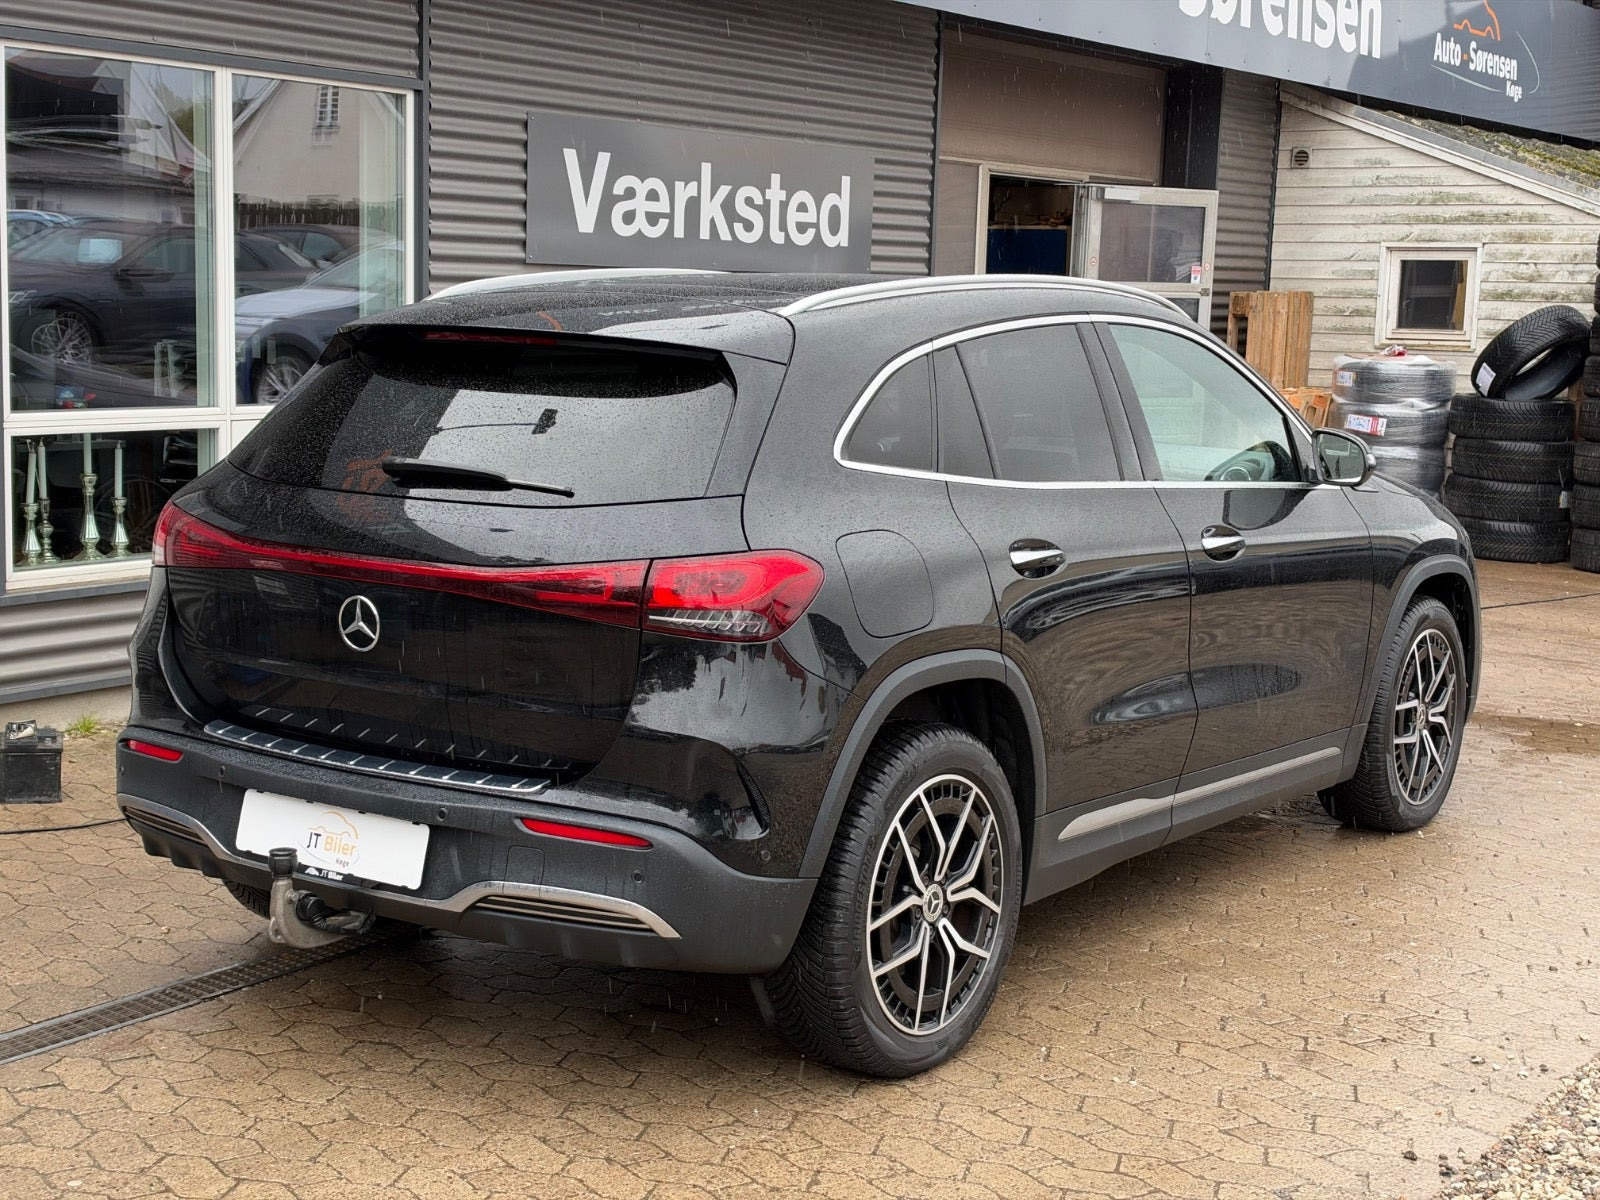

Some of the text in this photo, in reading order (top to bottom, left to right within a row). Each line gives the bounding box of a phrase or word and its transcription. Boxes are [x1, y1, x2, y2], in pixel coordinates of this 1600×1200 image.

[1433, 32, 1518, 81] Auto Sørensen
[563, 148, 851, 248] Værksted
[324, 835, 357, 857] Biler
